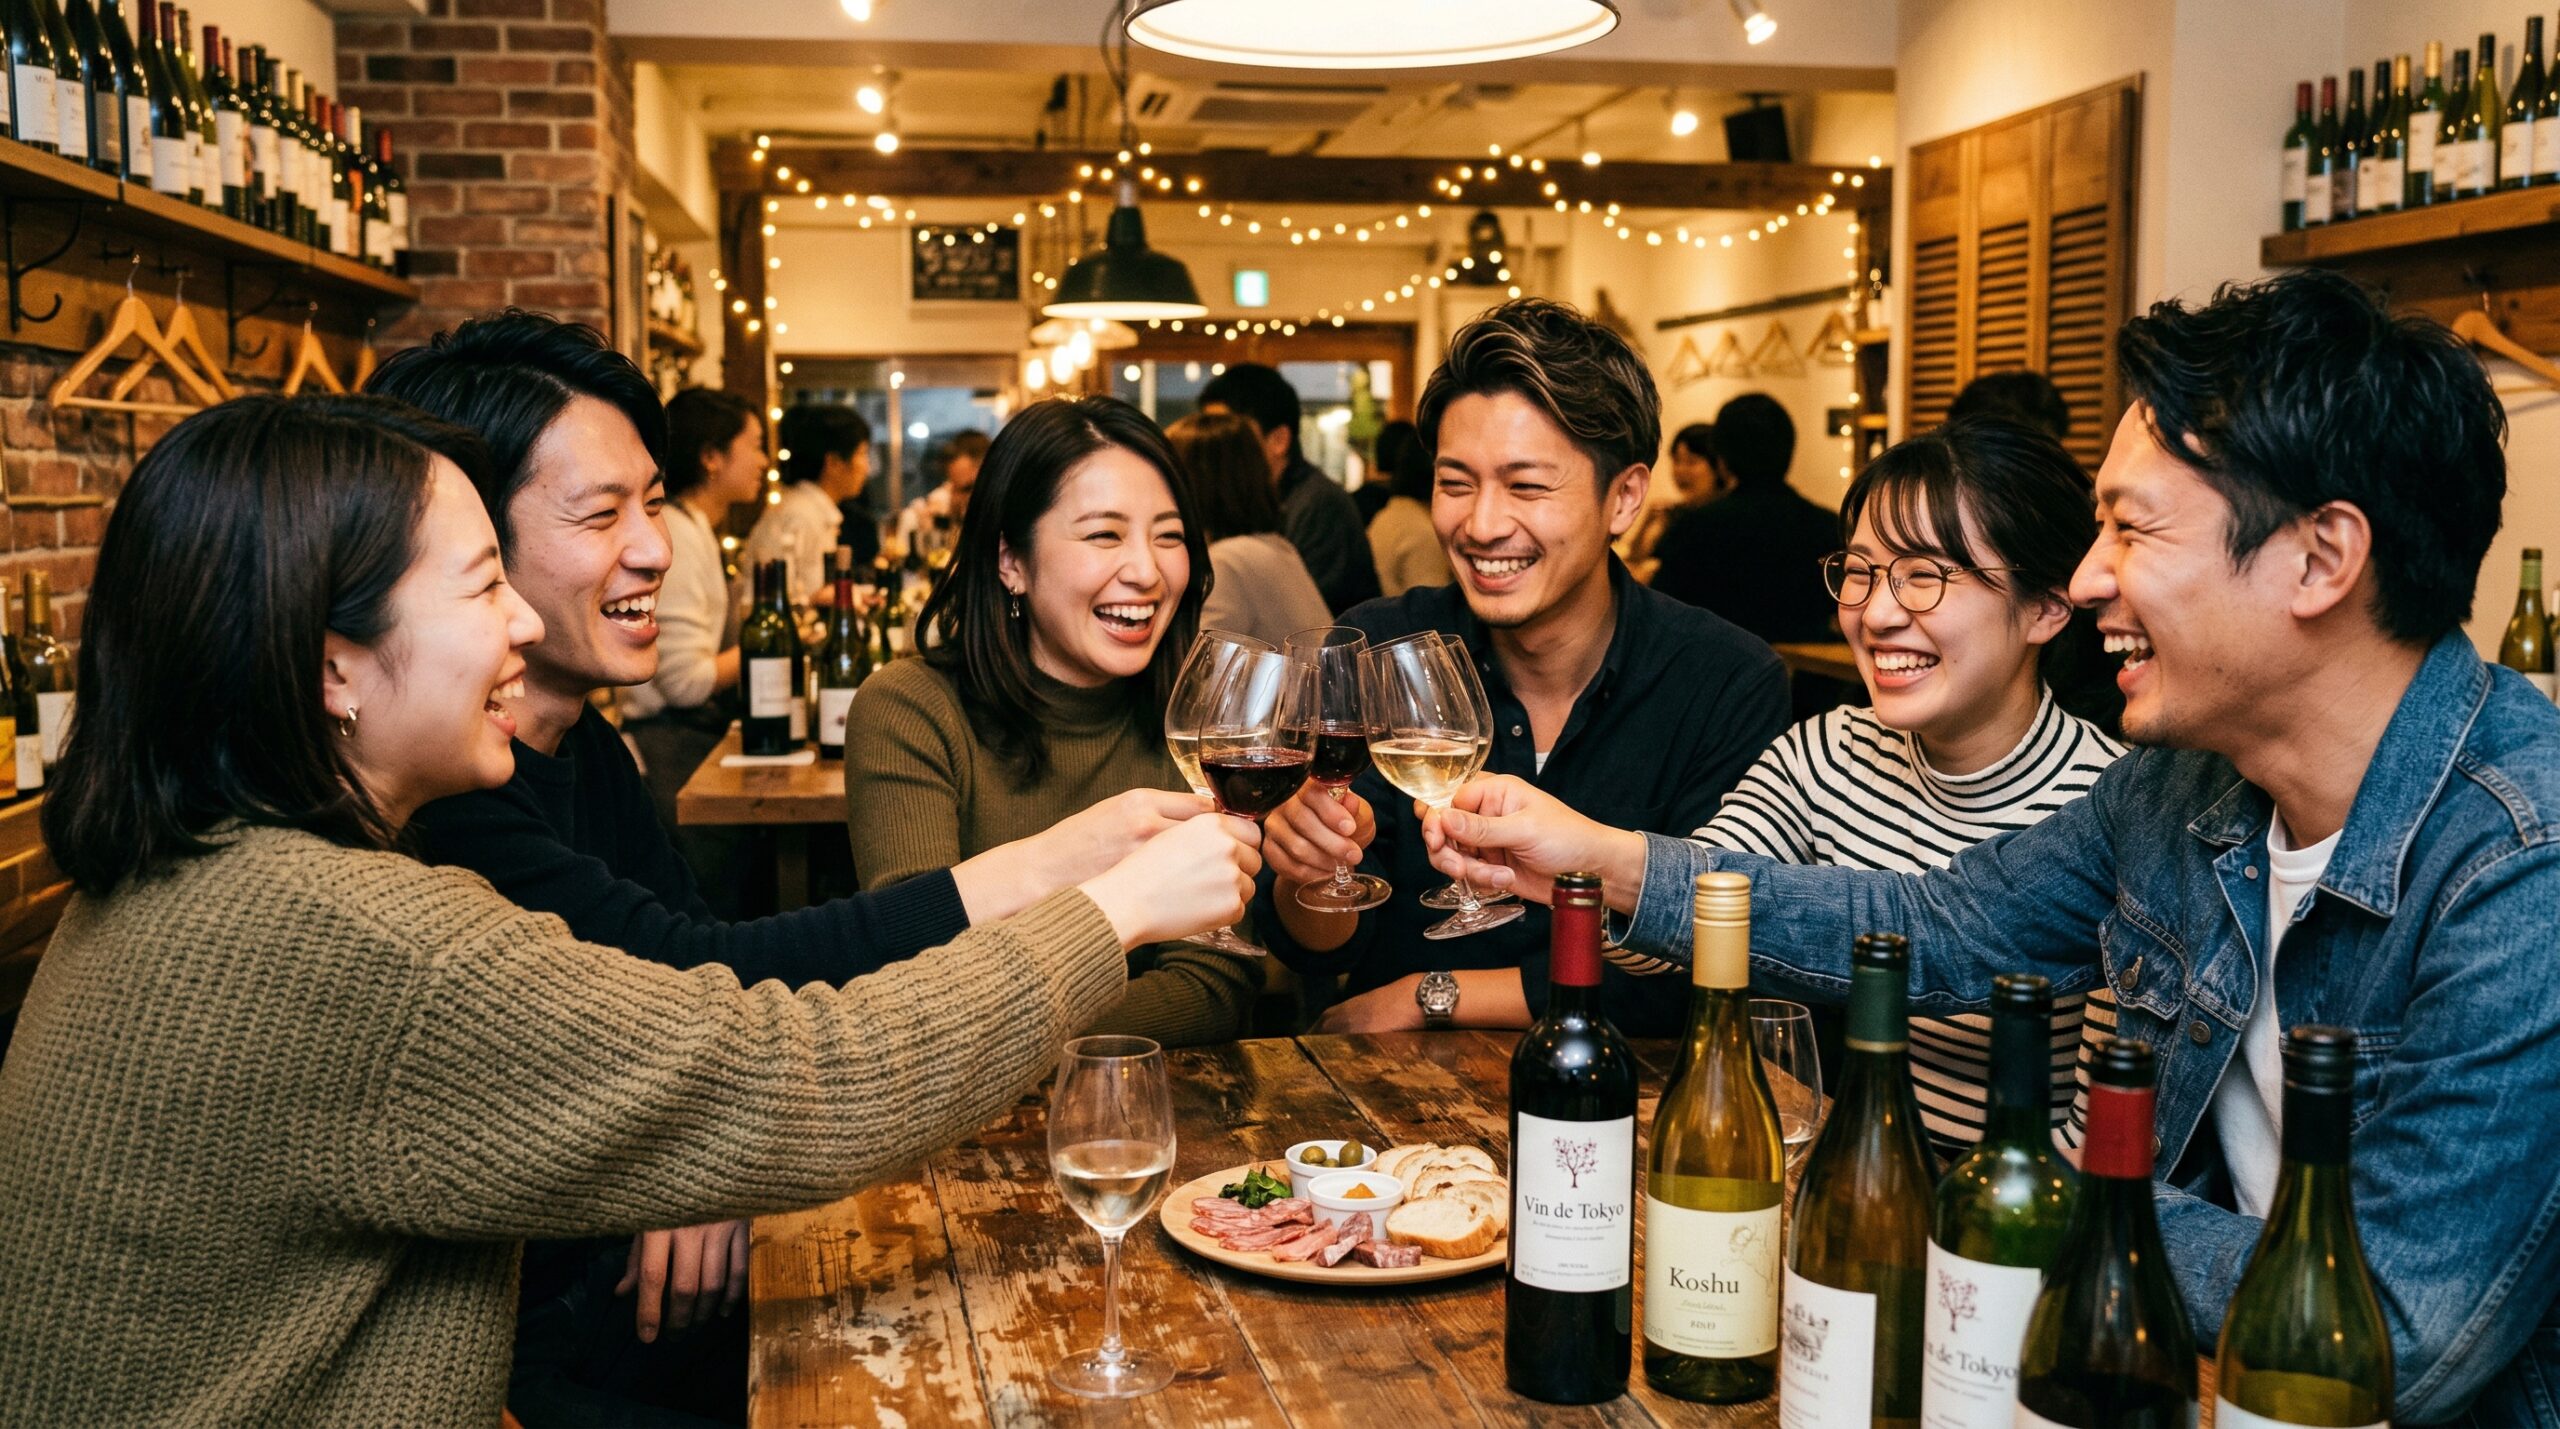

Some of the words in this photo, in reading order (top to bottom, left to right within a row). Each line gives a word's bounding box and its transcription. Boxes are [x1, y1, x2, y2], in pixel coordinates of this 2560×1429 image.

[1524, 1194, 1549, 1217] Vin
[1554, 1202, 1573, 1219] de
[1578, 1202, 1624, 1222] Tokyo
[1669, 1266, 1740, 1294] Koshu
[1957, 1350, 2018, 1383] Tokyo
